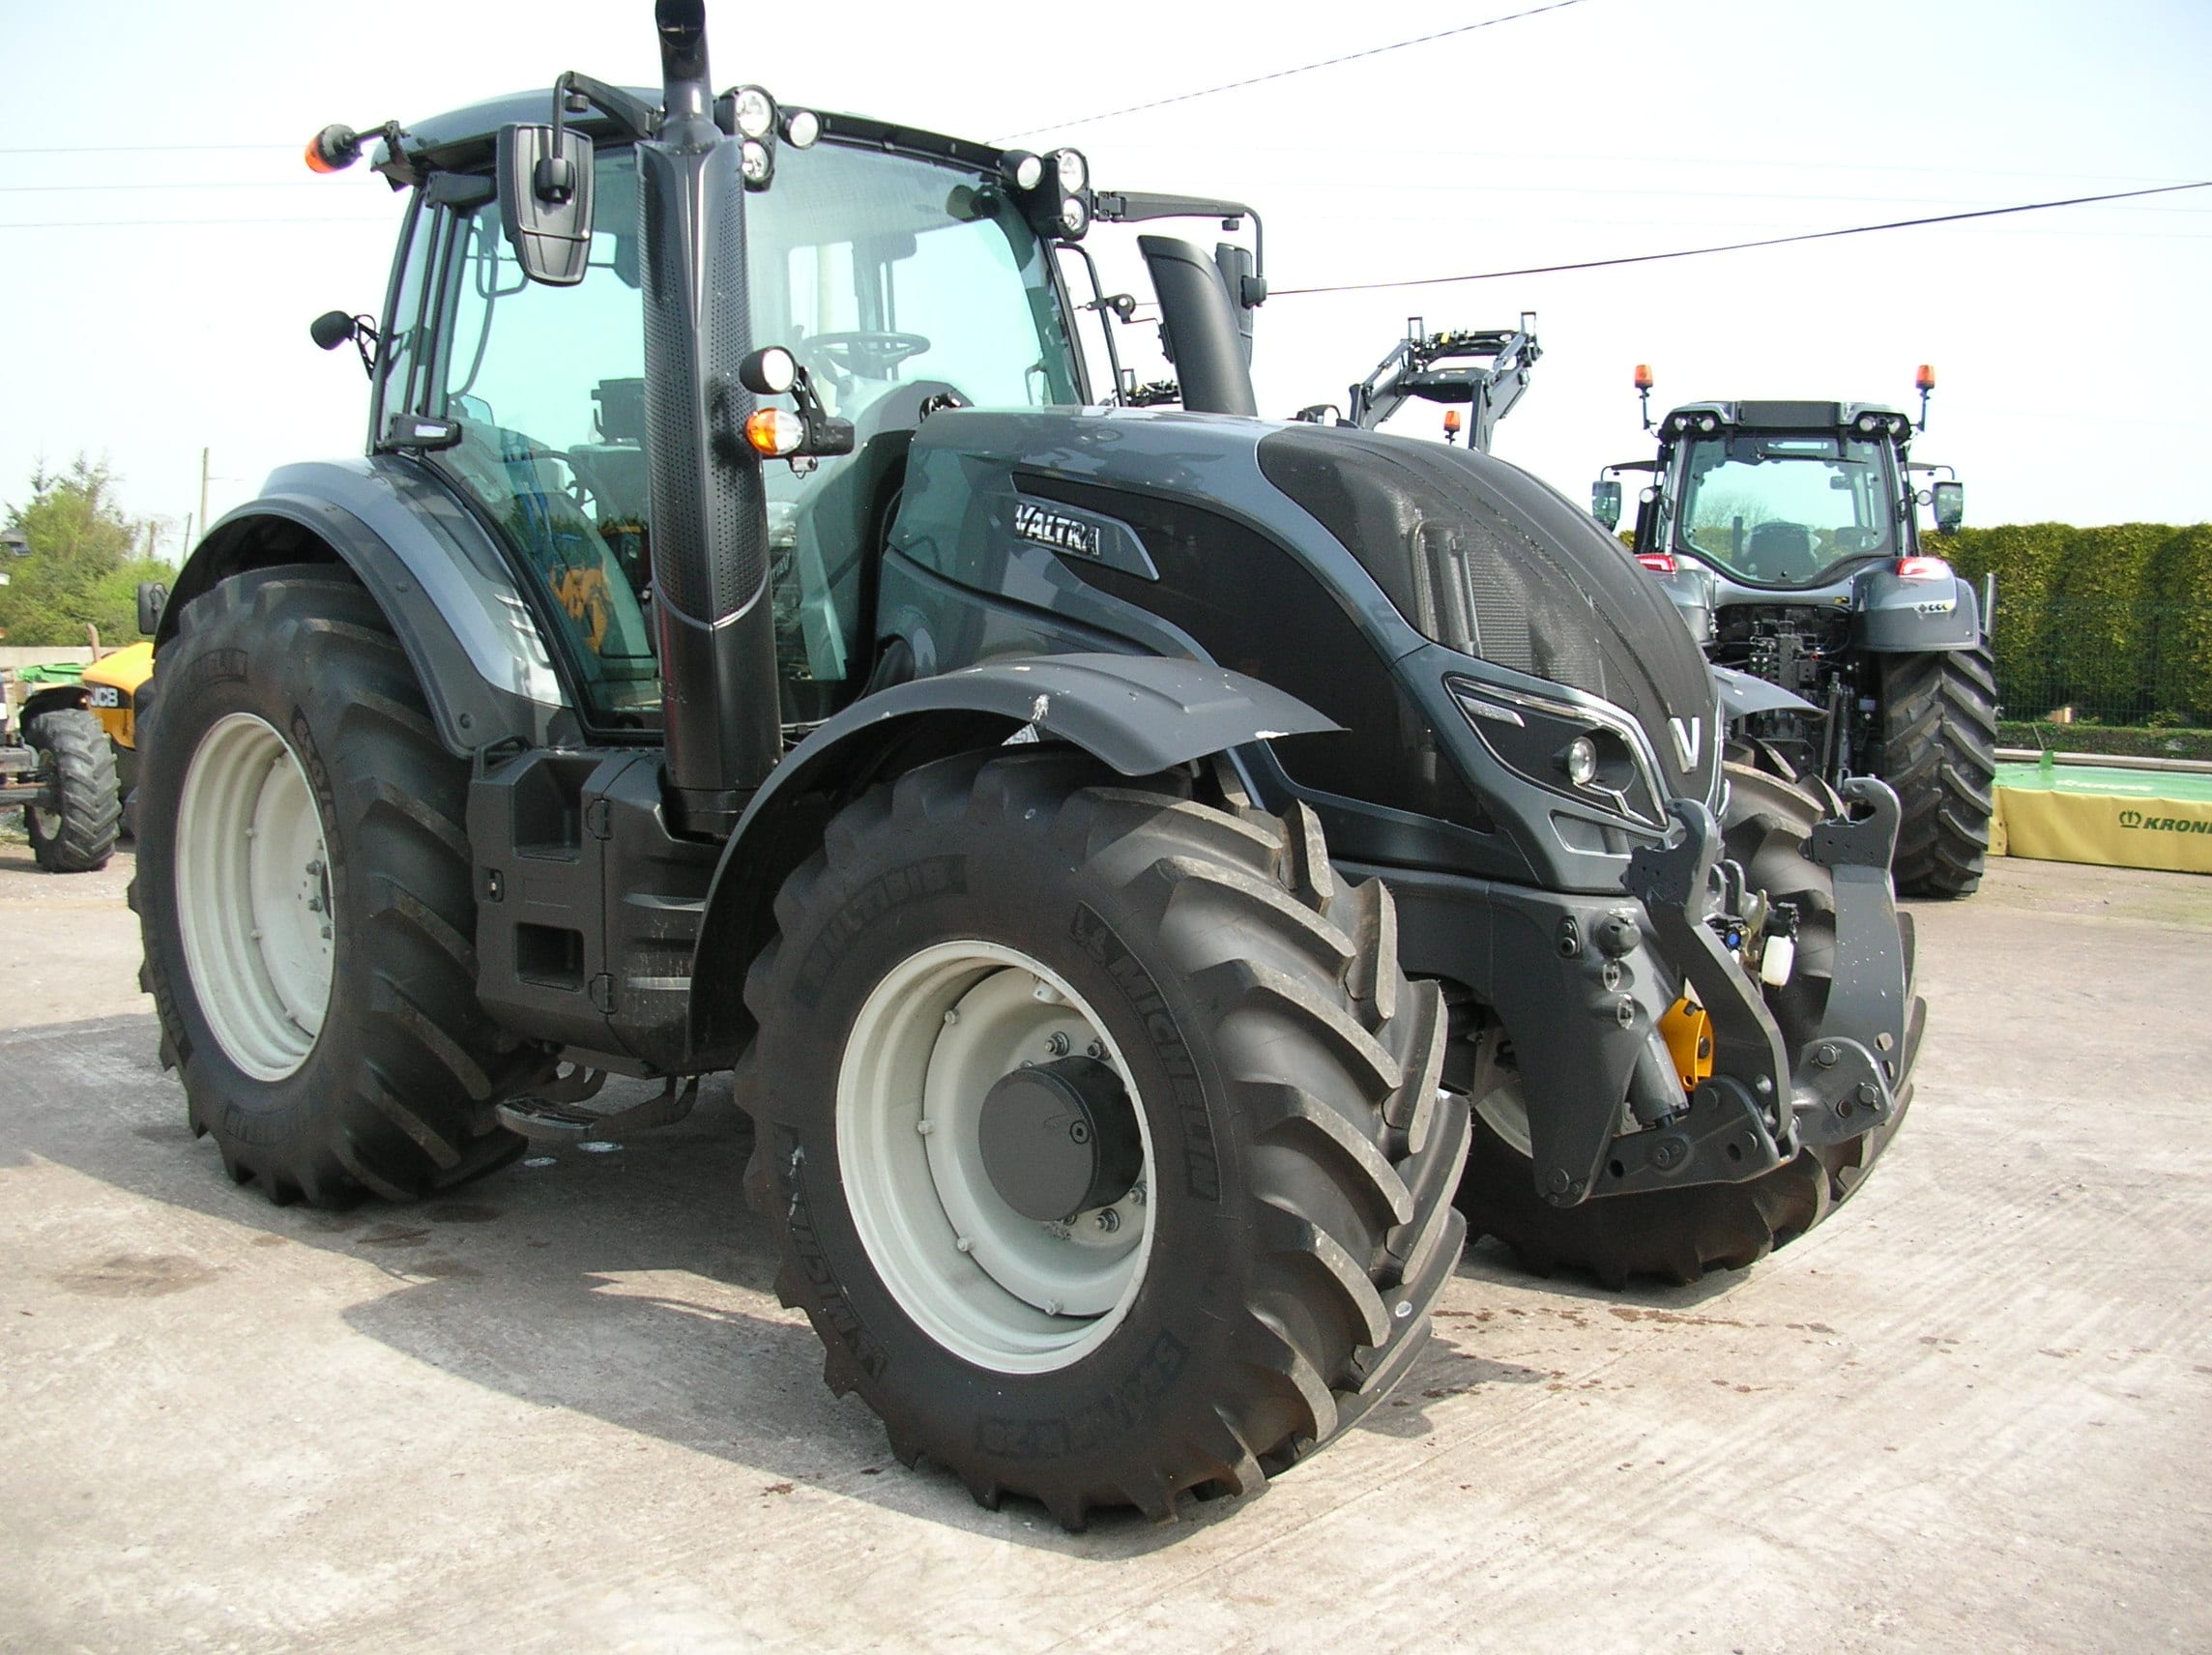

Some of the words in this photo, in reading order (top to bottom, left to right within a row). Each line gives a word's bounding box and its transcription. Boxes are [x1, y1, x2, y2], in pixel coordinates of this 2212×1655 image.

[1015, 504, 1100, 556] VALTRA
[90, 687, 118, 707] JCB
[1108, 953, 1220, 1201] MICHELIN
[774, 1125, 859, 1334] MICH
